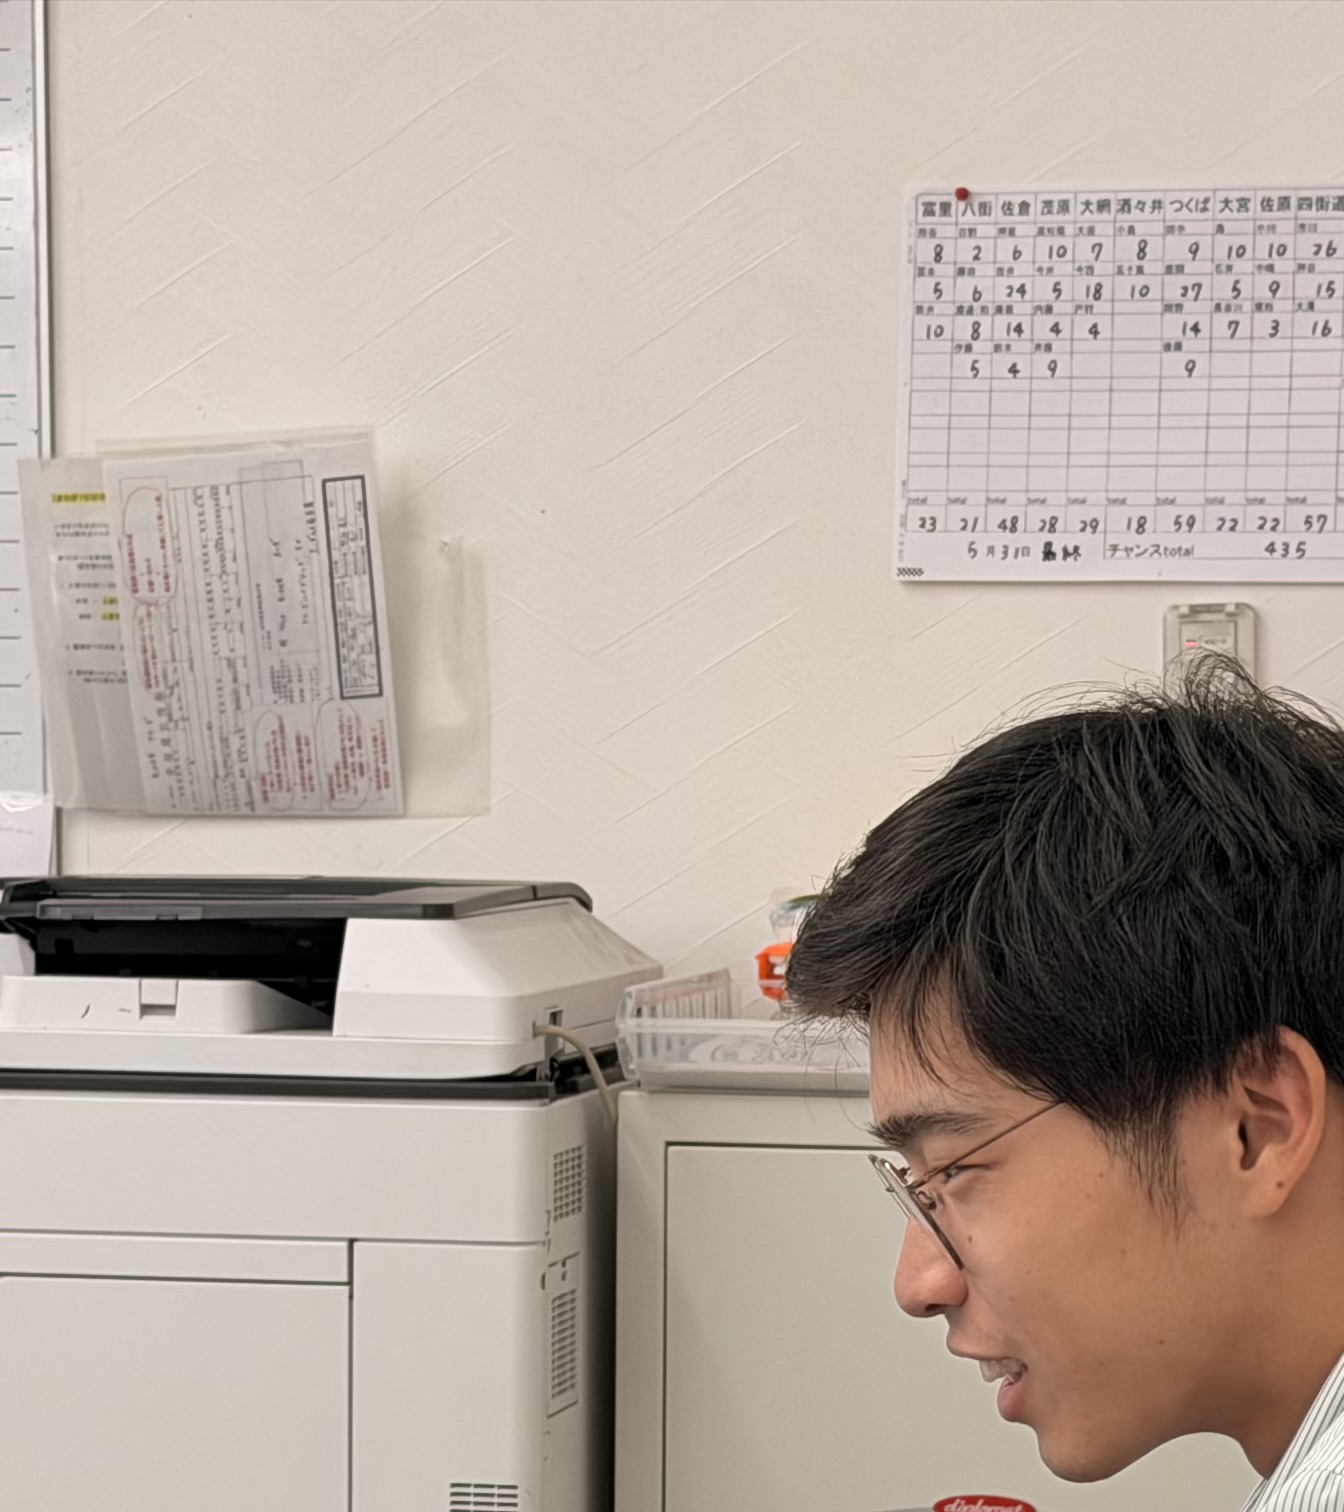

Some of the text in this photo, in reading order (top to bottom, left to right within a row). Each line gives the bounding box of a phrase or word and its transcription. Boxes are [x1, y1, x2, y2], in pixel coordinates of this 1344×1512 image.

[961, 200, 993, 217] 八街
[1000, 199, 1032, 217] 佐倉
[1169, 197, 1211, 214] つくば
[1219, 197, 1251, 213] 大宮
[1260, 196, 1292, 213] 佐原
[933, 243, 944, 264] 8
[971, 245, 983, 262] 2
[1012, 245, 1023, 261] 6
[1047, 244, 1067, 260] 10
[1090, 243, 1104, 262] 7
[1136, 239, 1148, 261] 8
[1188, 241, 1200, 261] 9
[1227, 244, 1246, 260] 10
[1268, 243, 1287, 258] 10
[1312, 240, 1338, 258] 26
[933, 281, 943, 300] 5
[972, 285, 982, 302] 6
[1006, 282, 1027, 300] 24
[1052, 281, 1063, 300] 5
[1085, 282, 1104, 301] 18
[1130, 284, 1150, 299] 10
[1180, 282, 1202, 302] 27
[1231, 279, 1242, 299] 5
[1268, 280, 1280, 298] 9
[1316, 280, 1336, 298] 15
[918, 515, 937, 533] 23
[959, 516, 978, 532] 21
[997, 515, 1019, 534] 48
[1038, 515, 1058, 534] 28
[1079, 517, 1099, 534] 29
[1126, 515, 1147, 535] 18
[1173, 514, 1196, 533] 59
[1216, 516, 1239, 532] 22
[1256, 516, 1281, 532] 22
[1304, 514, 1328, 534] 57
[1264, 541, 1307, 559] 435
